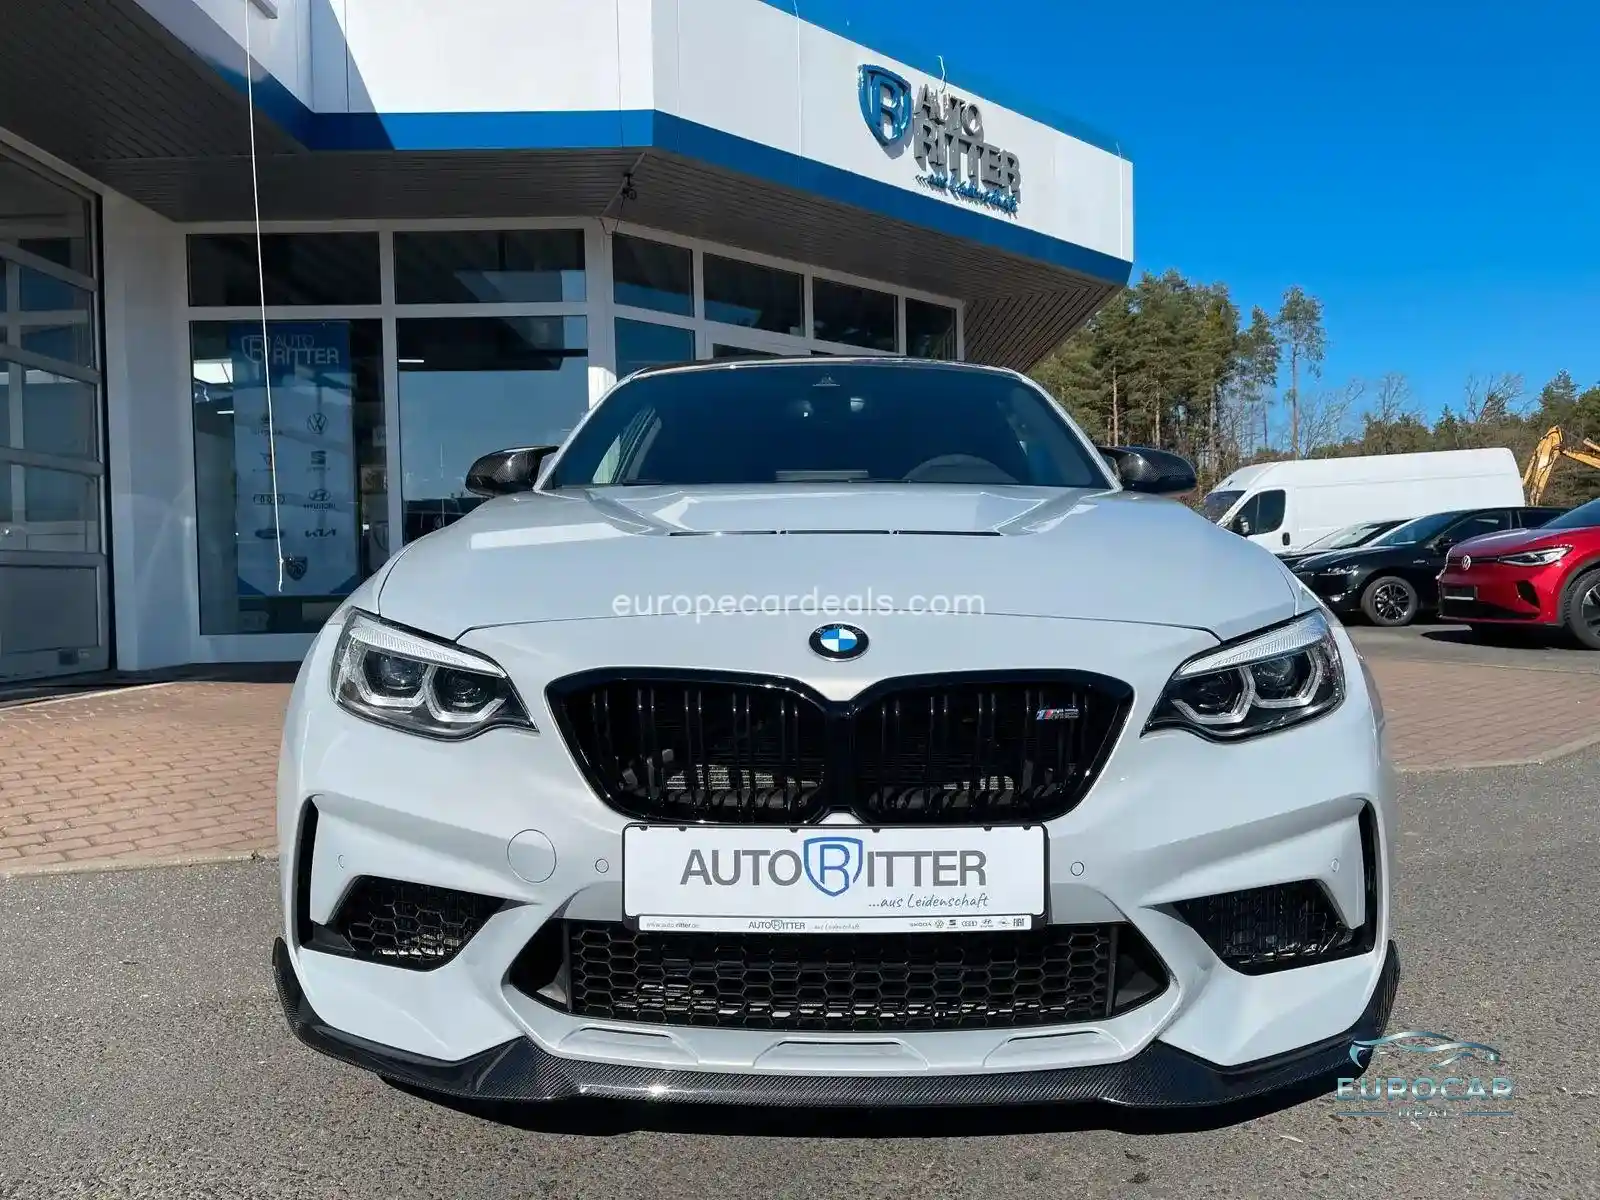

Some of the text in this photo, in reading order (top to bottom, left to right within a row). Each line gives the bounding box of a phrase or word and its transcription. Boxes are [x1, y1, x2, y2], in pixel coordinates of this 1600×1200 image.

[913, 84, 983, 138] AUTO
[914, 124, 1021, 197] RITTER
[274, 335, 315, 349] AUTO
[272, 347, 340, 364] RITTER
[907, 892, 989, 909] Leidenschaft
